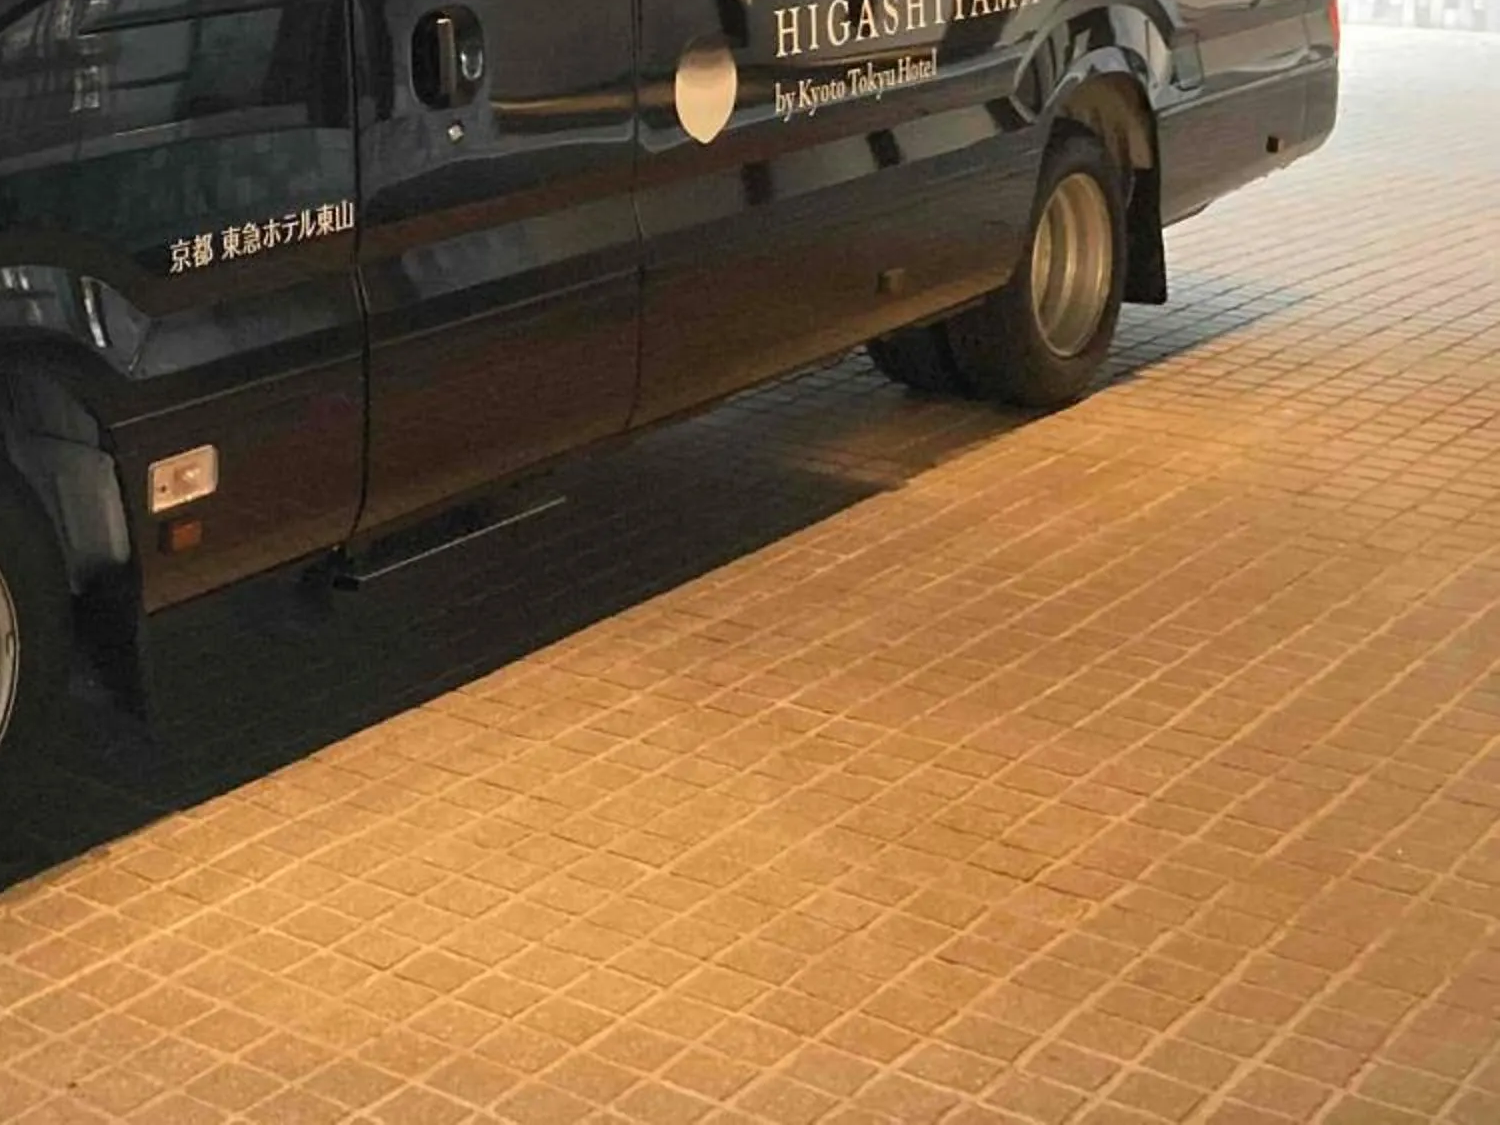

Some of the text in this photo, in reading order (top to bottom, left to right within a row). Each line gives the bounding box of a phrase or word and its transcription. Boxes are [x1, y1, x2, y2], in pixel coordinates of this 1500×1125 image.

[774, 47, 938, 123] by Kyoto Tokyu Hotel
[169, 198, 355, 274] 京都 東急ホテル東山
